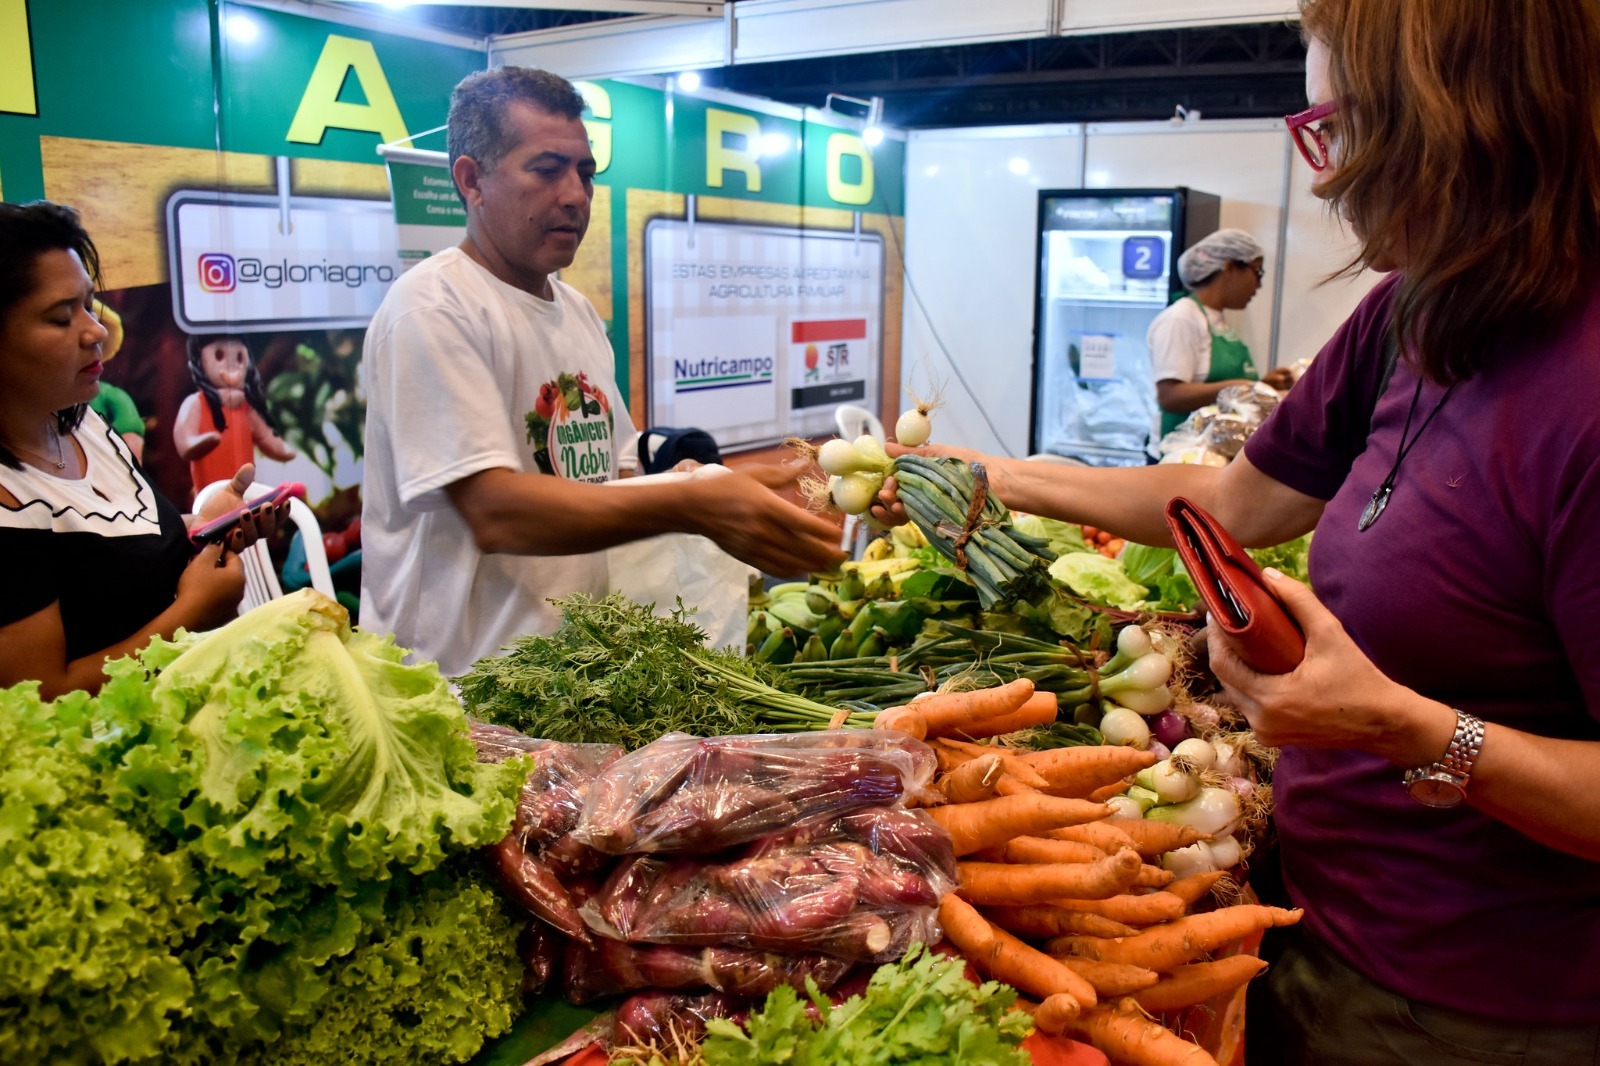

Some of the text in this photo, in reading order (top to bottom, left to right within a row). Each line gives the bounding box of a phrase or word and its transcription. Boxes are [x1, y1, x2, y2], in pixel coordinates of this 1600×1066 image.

[1134, 246, 1152, 271] 2
[673, 264, 715, 279] ESTAS
[720, 264, 790, 280] EMPRESAS
[709, 284, 794, 299] AGRICULTURA
[674, 356, 773, 379] Nutricampo
[827, 343, 849, 375] STR
